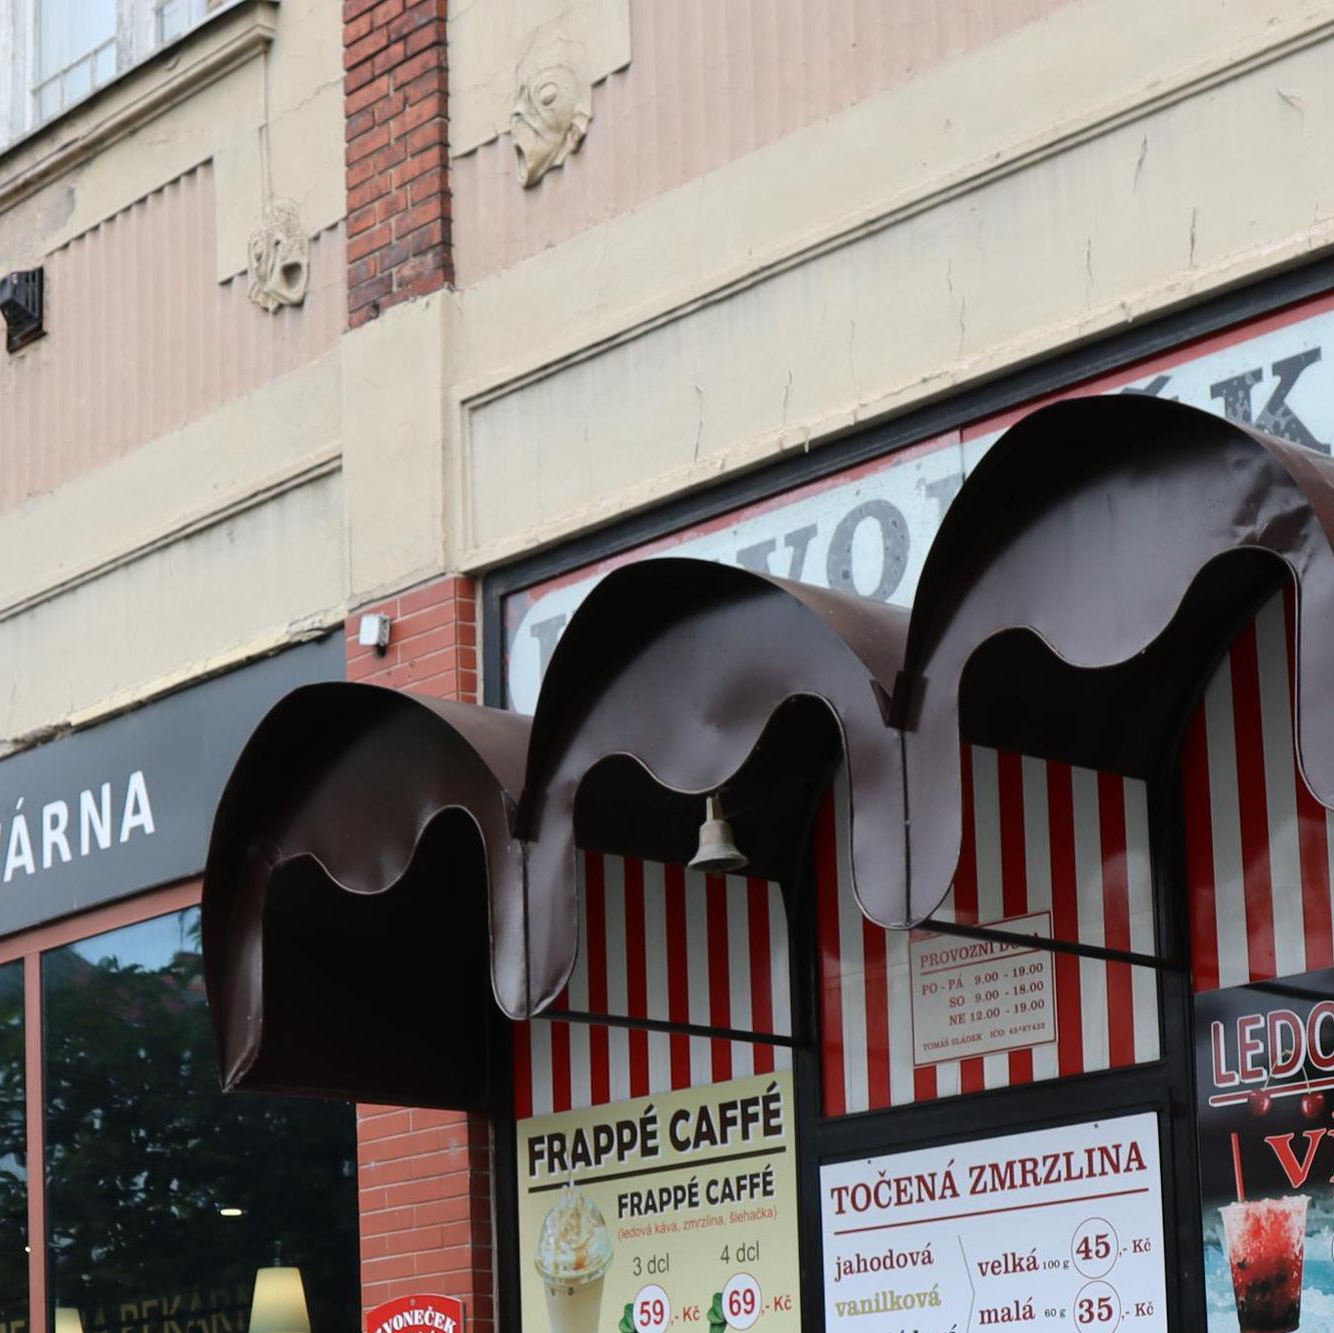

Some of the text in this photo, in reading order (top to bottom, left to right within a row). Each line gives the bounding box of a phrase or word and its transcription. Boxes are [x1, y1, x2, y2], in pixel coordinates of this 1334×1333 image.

[922, 983, 938, 996] PO
[974, 971, 999, 986] 9.00
[1012, 962, 1043, 978] 19.00
[949, 995, 965, 1009] SO
[975, 990, 999, 1003] 9.00
[1013, 981, 1044, 996] 18.00
[949, 1012, 967, 1026] NE
[970, 1007, 1000, 1022] 12.00
[1014, 999, 1045, 1014] 19.00
[528, 1080, 782, 1178] FRAPPÉ CAFFÉ
[618, 1163, 775, 1219] FRAPPÉ CAFFÉ
[831, 1141, 1147, 1215] TOČENÁ ZMRZLINA
[633, 1252, 670, 1277] 3 dcl
[721, 1240, 760, 1264] 4 dcl
[835, 1242, 933, 1282] jahodová
[978, 1247, 1039, 1277] velká
[1043, 1260, 1060, 1269] 100
[1132, 1238, 1151, 1253] Kč
[683, 1306, 701, 1321] Kč
[774, 1295, 792, 1311] Kč
[835, 1283, 942, 1318] vanilková
[979, 1296, 1035, 1325] malá
[1044, 1308, 1057, 1317] 60
[1135, 1301, 1154, 1317] Kč
